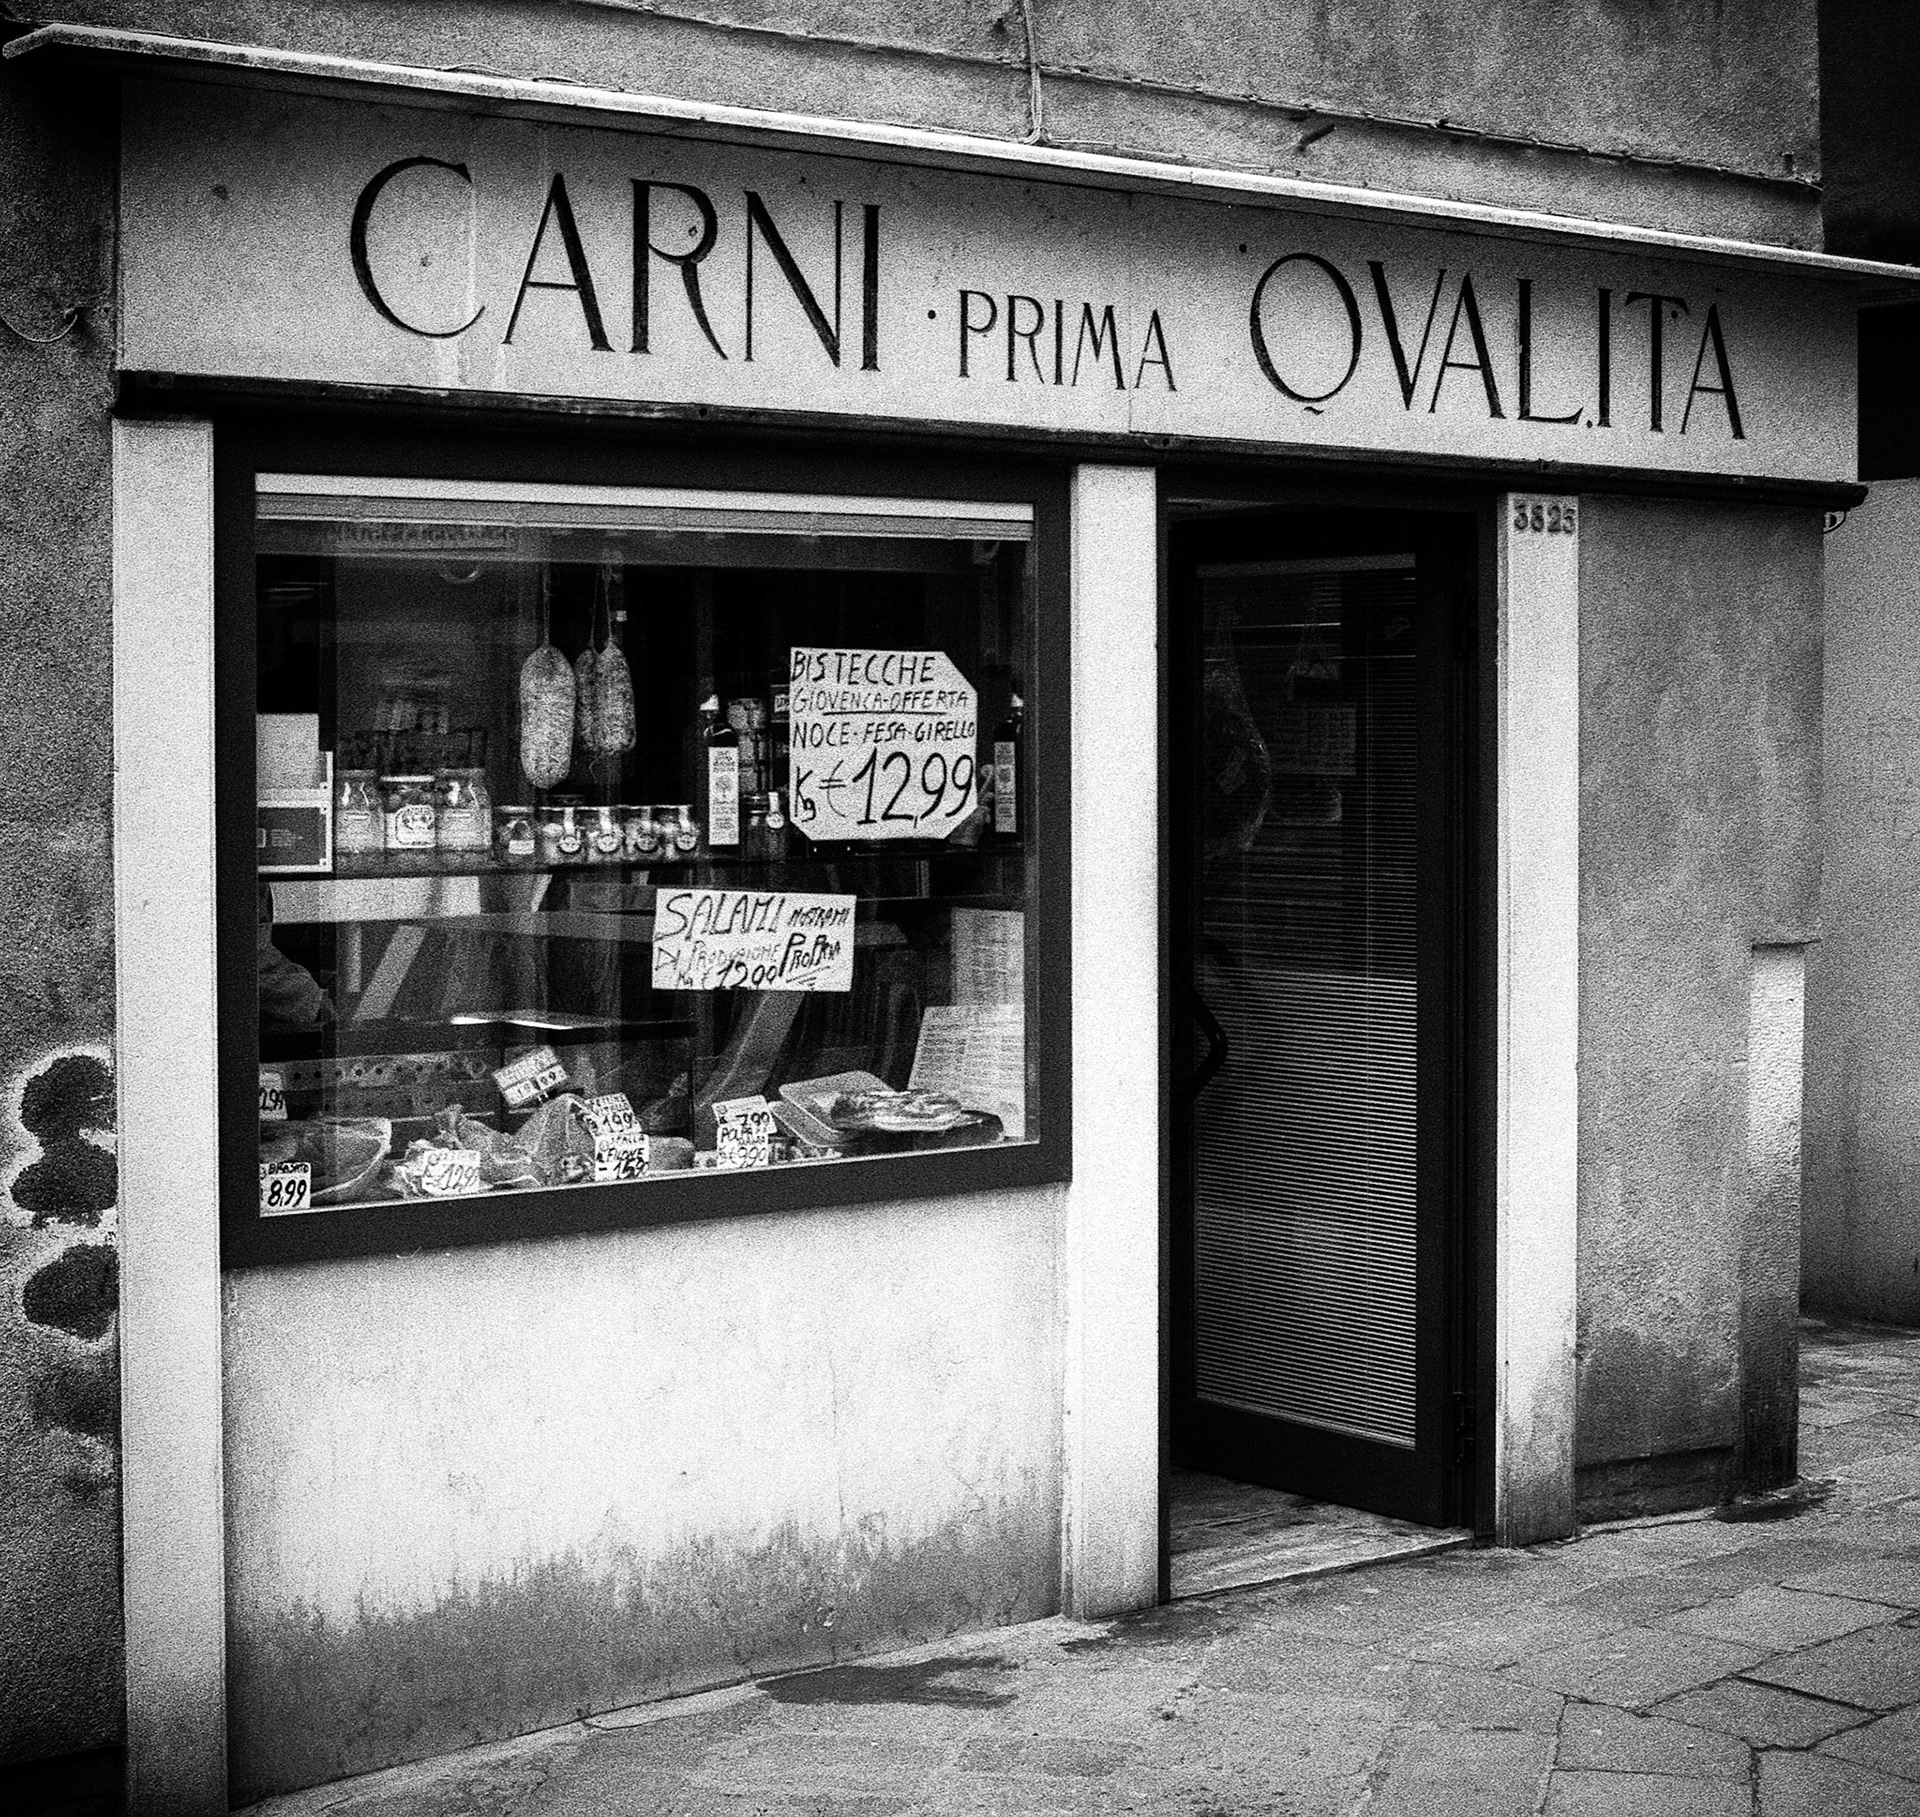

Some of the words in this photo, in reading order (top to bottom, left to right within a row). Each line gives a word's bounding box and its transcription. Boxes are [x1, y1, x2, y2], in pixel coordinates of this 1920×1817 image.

[350, 156, 882, 372] CARNI
[958, 289, 1178, 392] PRIMA
[791, 650, 936, 686] BISTECCHE
[653, 893, 787, 942] SALAMI
